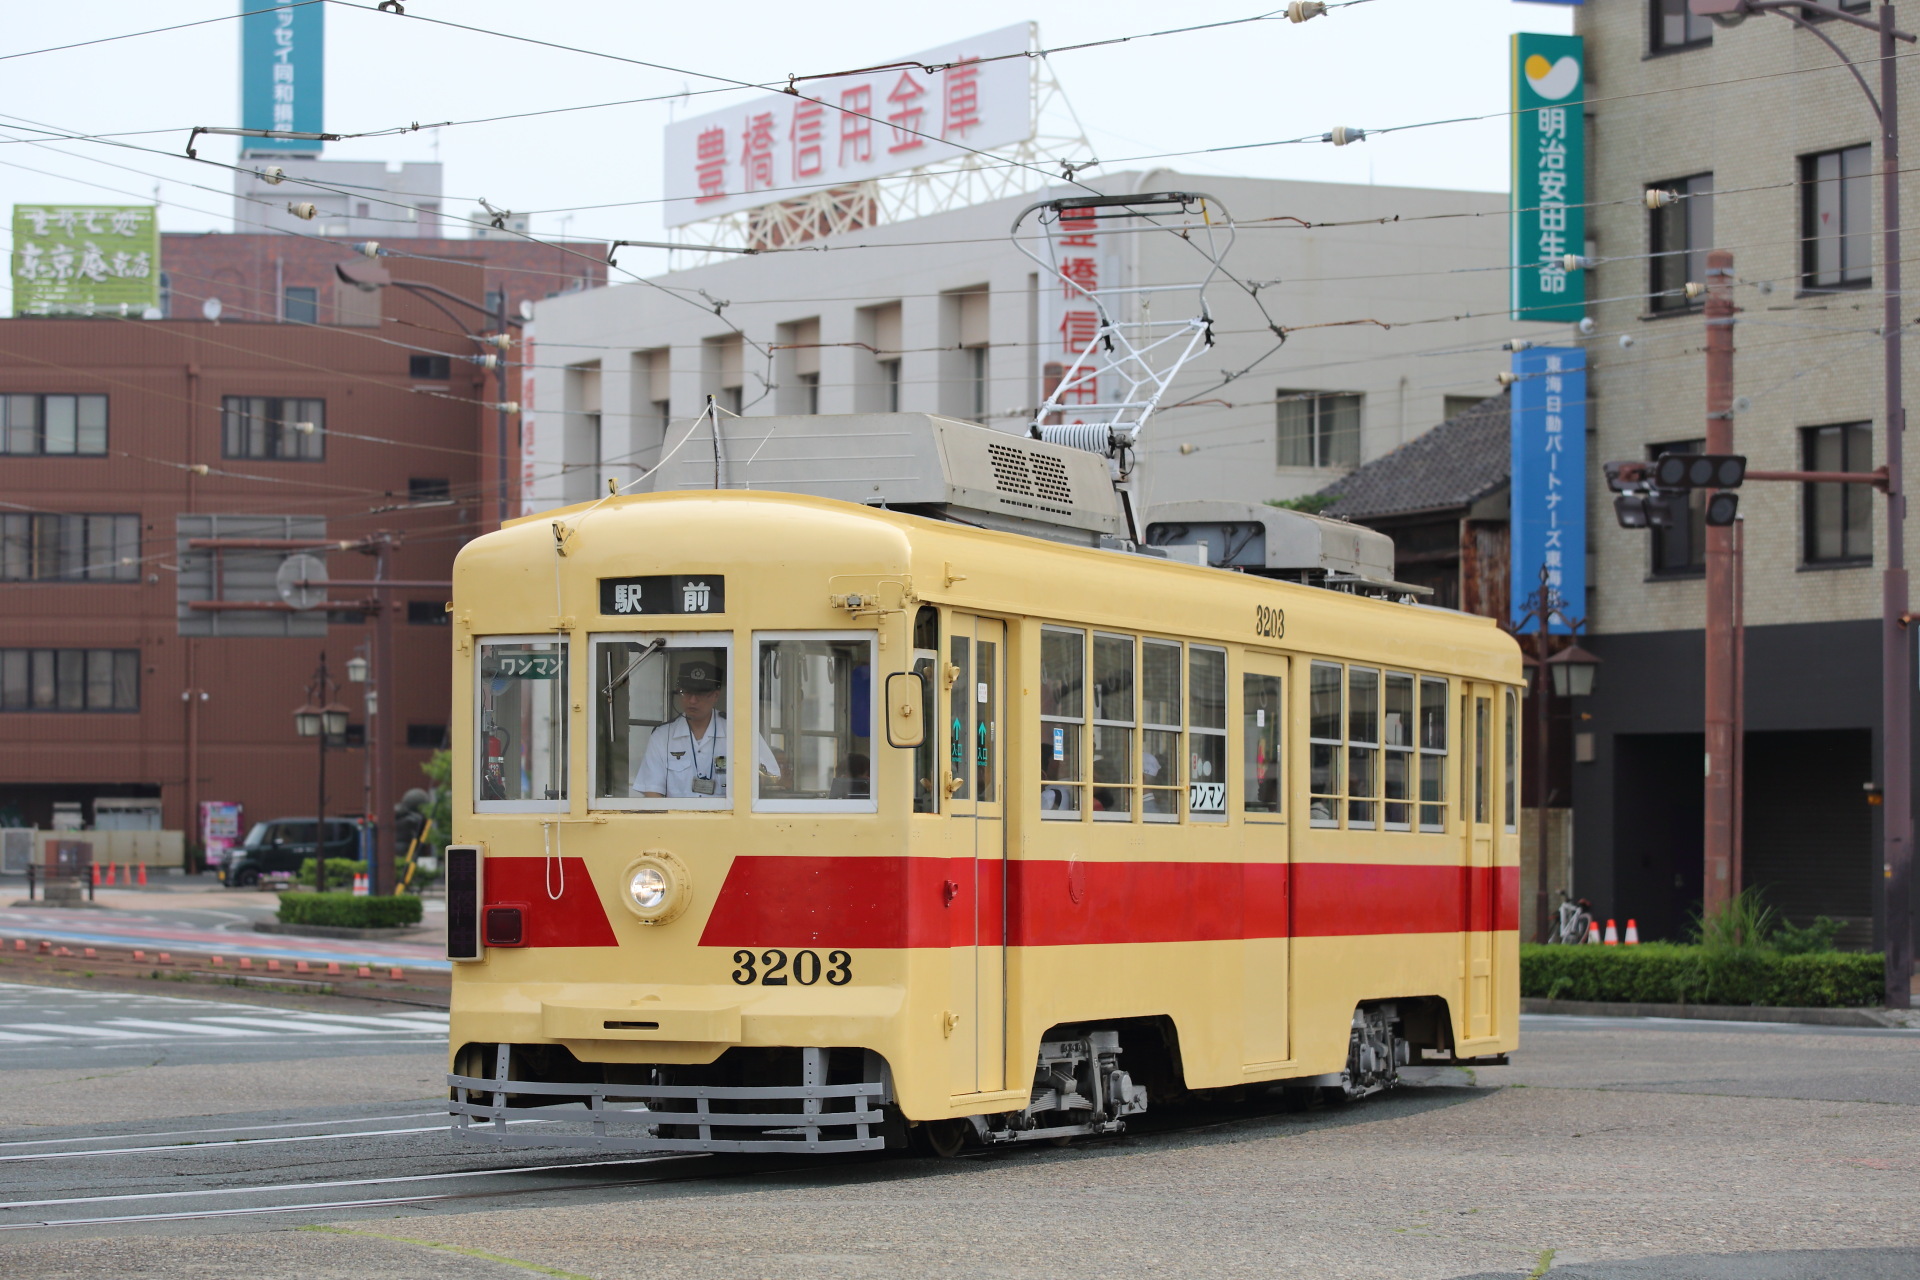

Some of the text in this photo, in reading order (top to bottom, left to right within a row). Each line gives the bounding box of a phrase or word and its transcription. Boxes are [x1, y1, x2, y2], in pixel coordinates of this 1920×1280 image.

[694, 54, 981, 205] 豊橋信用金庫
[1538, 107, 1566, 294] 明治安田生命
[1059, 206, 1098, 425] 豊橋信用
[615, 581, 711, 613] 駅前
[1256, 605, 1285, 639] 3203
[501, 658, 563, 676] ワンマン
[1190, 784, 1225, 809] ワンマン
[732, 949, 853, 986] 3203
